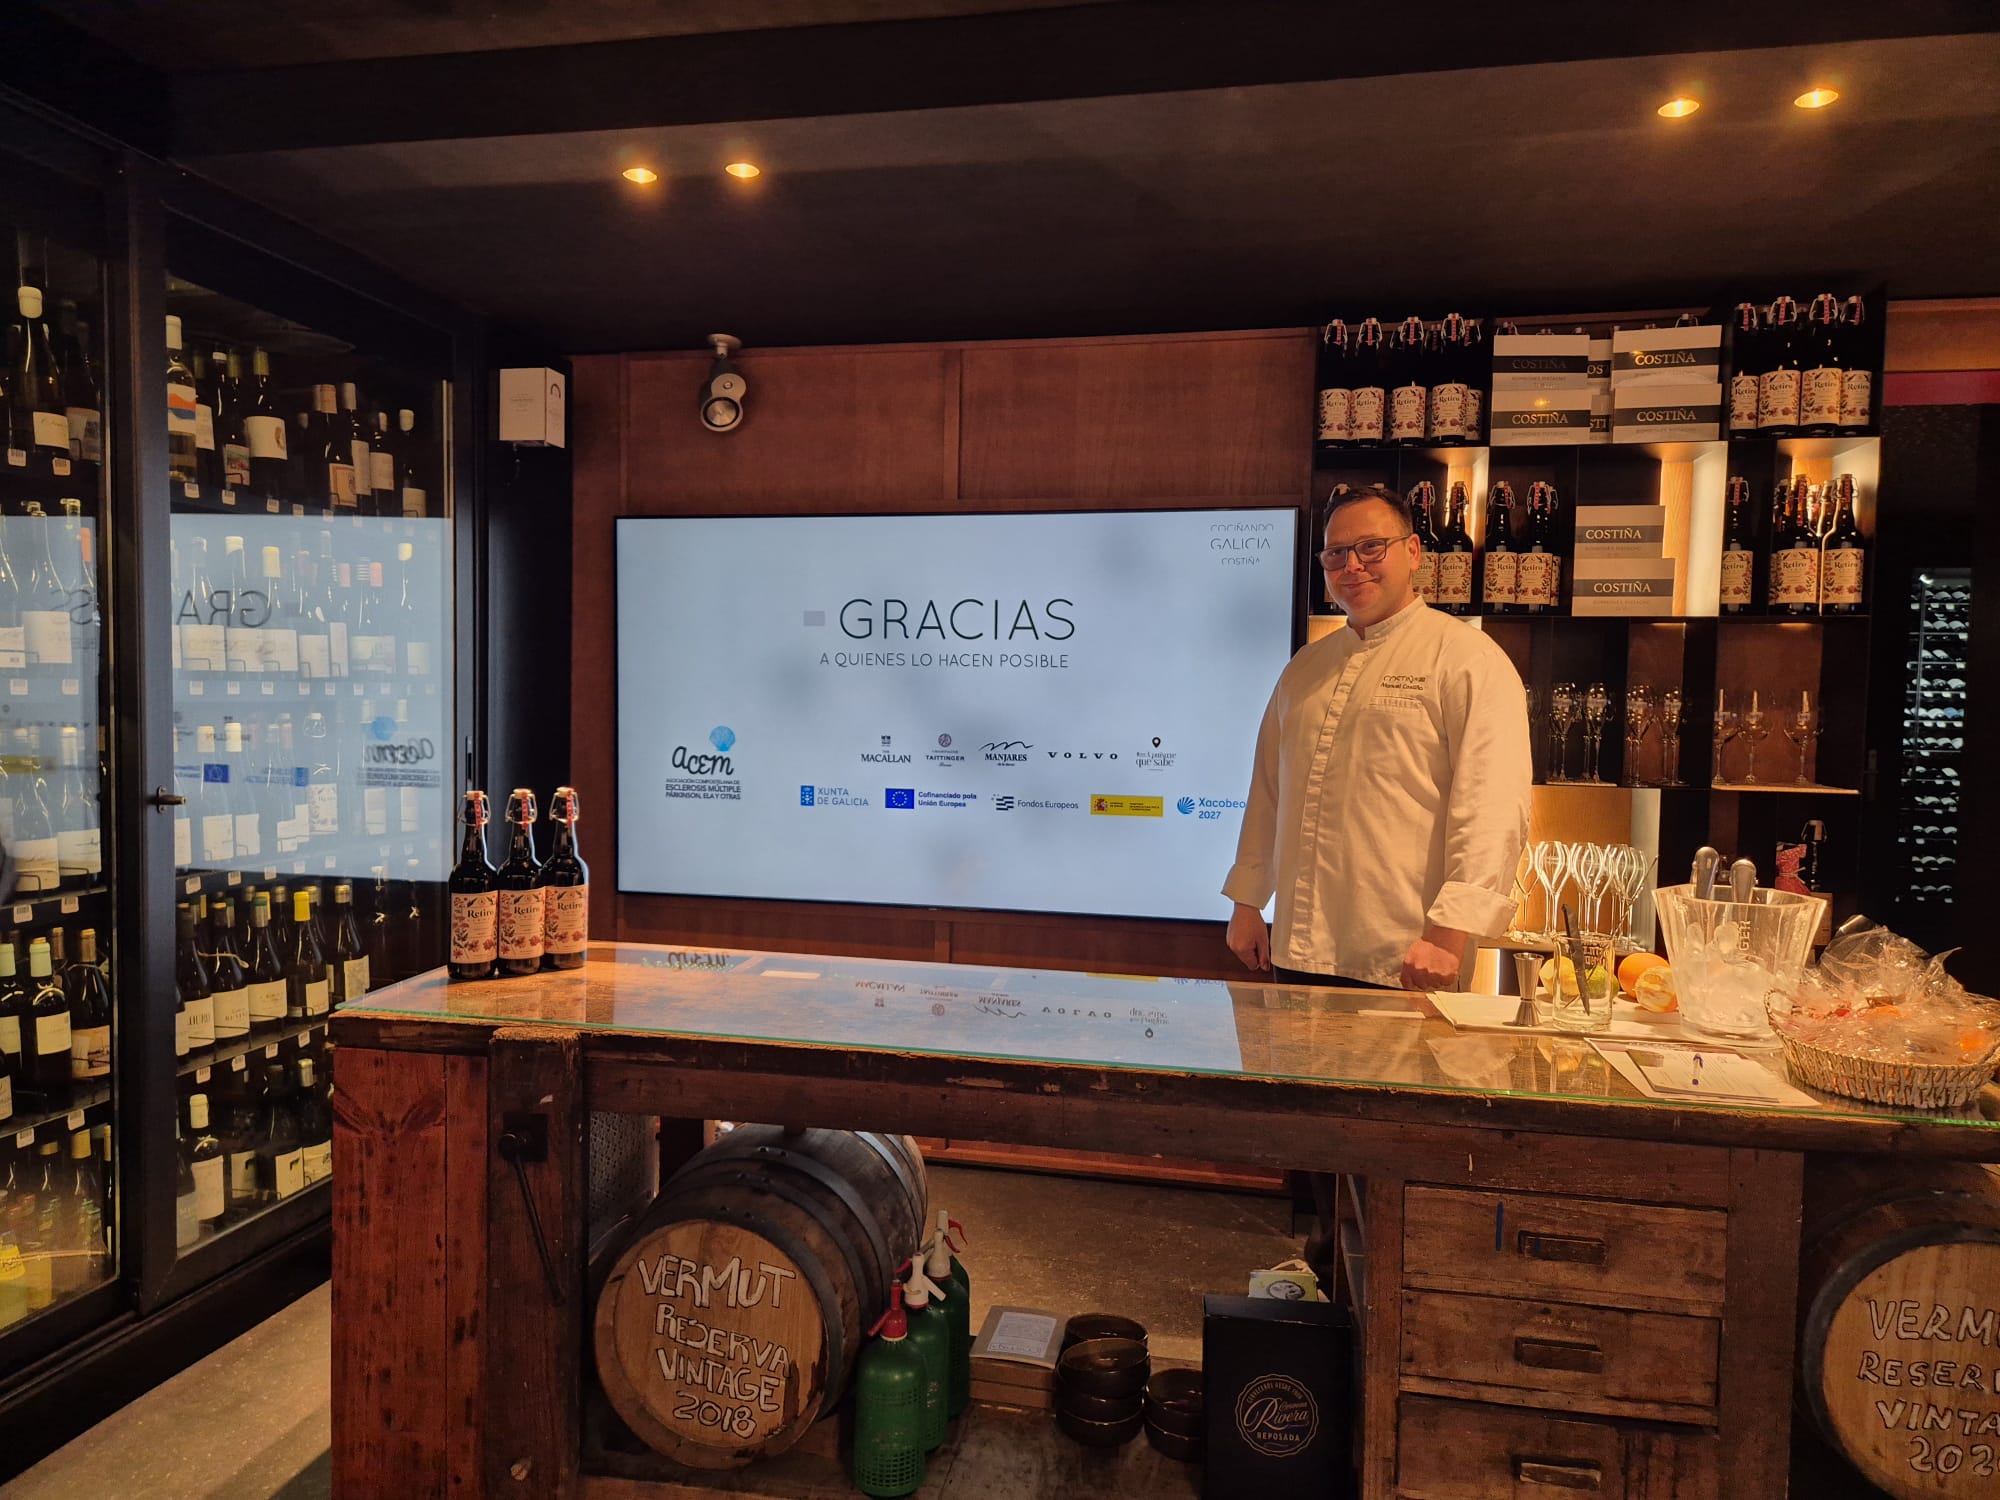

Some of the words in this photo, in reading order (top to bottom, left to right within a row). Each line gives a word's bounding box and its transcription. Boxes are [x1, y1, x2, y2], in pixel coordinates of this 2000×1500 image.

[1511, 359, 1567, 370] COSTIÑA
[1634, 352, 1696, 366] COSTIÑA
[1511, 411, 1569, 425] COSTIÑA
[1636, 408, 1697, 422] COSTIÑA
[1585, 527, 1642, 540] COSTIÑA
[1210, 537, 1271, 550] GALICIA
[1593, 581, 1652, 593] COSTIÑA
[839, 598, 1076, 640] GRACIAS
[820, 652, 830, 665] A
[834, 652, 906, 667] QUIENES
[911, 653, 933, 666] LO
[938, 653, 993, 667] HACEN
[999, 653, 1069, 668] POSIBLE
[860, 753, 911, 763] MACALLAN
[985, 753, 1028, 762] MANJARES
[1047, 751, 1119, 760] VOLVO
[665, 783, 707, 792] ESCLEROSIS
[708, 784, 742, 793] MÚLTIPLE
[817, 787, 849, 796] XUNTA
[918, 791, 961, 800] Cofinanciado
[817, 797, 829, 805] DE
[831, 797, 869, 807] GALICIA
[918, 799, 938, 807] Unión
[939, 801, 967, 809] Europea
[1017, 799, 1044, 809] Fondos
[1045, 801, 1079, 811] Europeos
[1199, 797, 1246, 809] Xacobeo
[1199, 811, 1222, 820] 2027
[637, 1254, 796, 1308] VERMUT
[1868, 1299, 2000, 1346] VERM
[655, 1303, 792, 1378] RESERVA
[1857, 1350, 2000, 1394] RESER
[656, 1348, 781, 1412] VINTAGE
[673, 1390, 757, 1438] 2018
[1256, 1431, 1300, 1441] REPOSADA
[1909, 1436, 2000, 1477] 202
